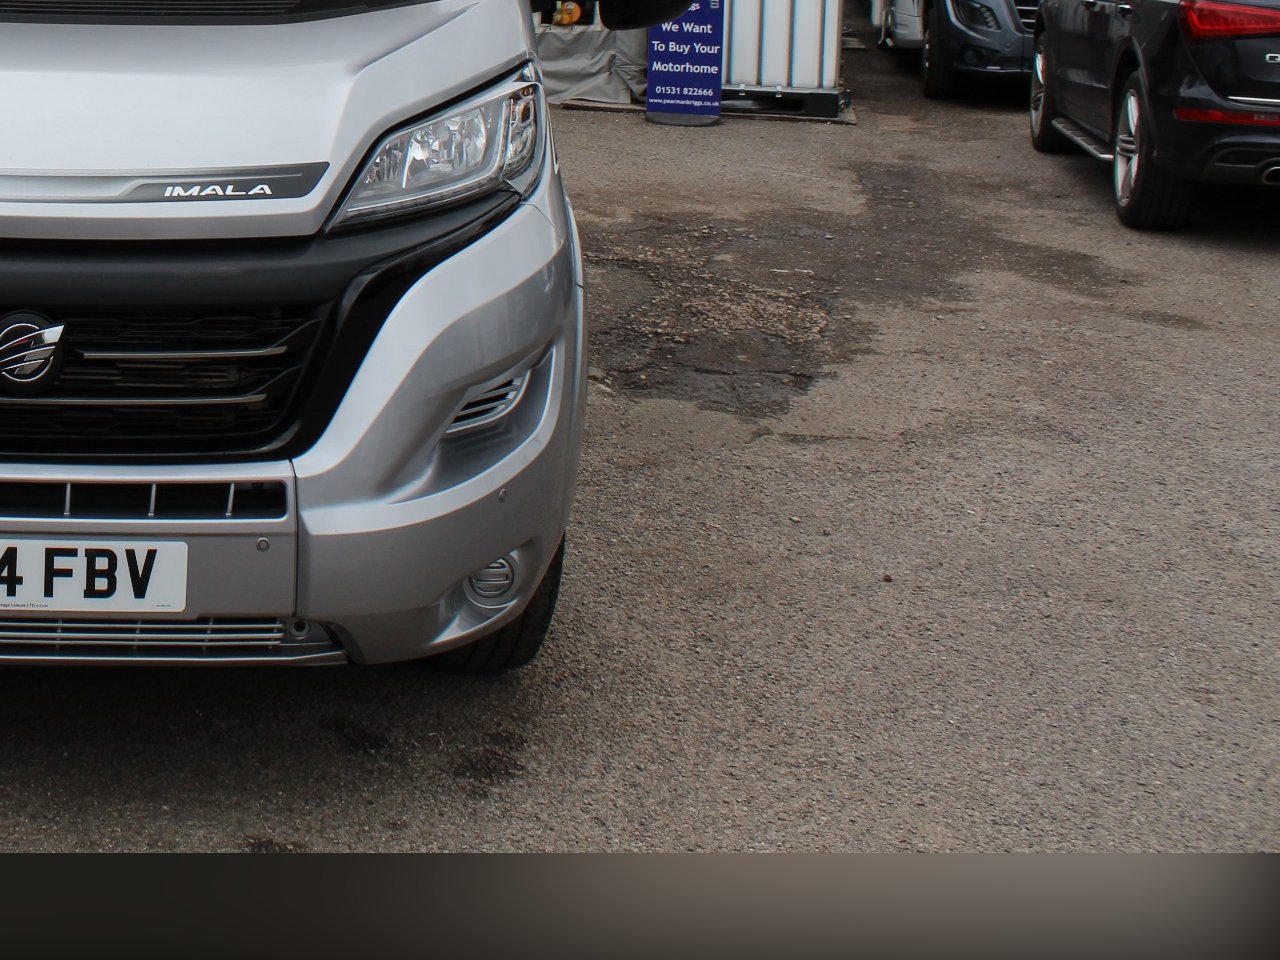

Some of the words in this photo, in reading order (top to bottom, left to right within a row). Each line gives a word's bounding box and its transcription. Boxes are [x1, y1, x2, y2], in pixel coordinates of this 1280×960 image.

[661, 22, 680, 33] We
[682, 22, 713, 34] Want
[652, 41, 666, 52] To
[669, 42, 690, 55] Buy
[693, 43, 720, 54] Your
[652, 61, 719, 74] Motorhome
[655, 86, 680, 95] 01531
[683, 87, 714, 97] 822666
[649, 97, 720, 107] www.pearmanbriggs.co.uk
[163, 184, 273, 198] IMALA
[43, 547, 158, 600] FBV
